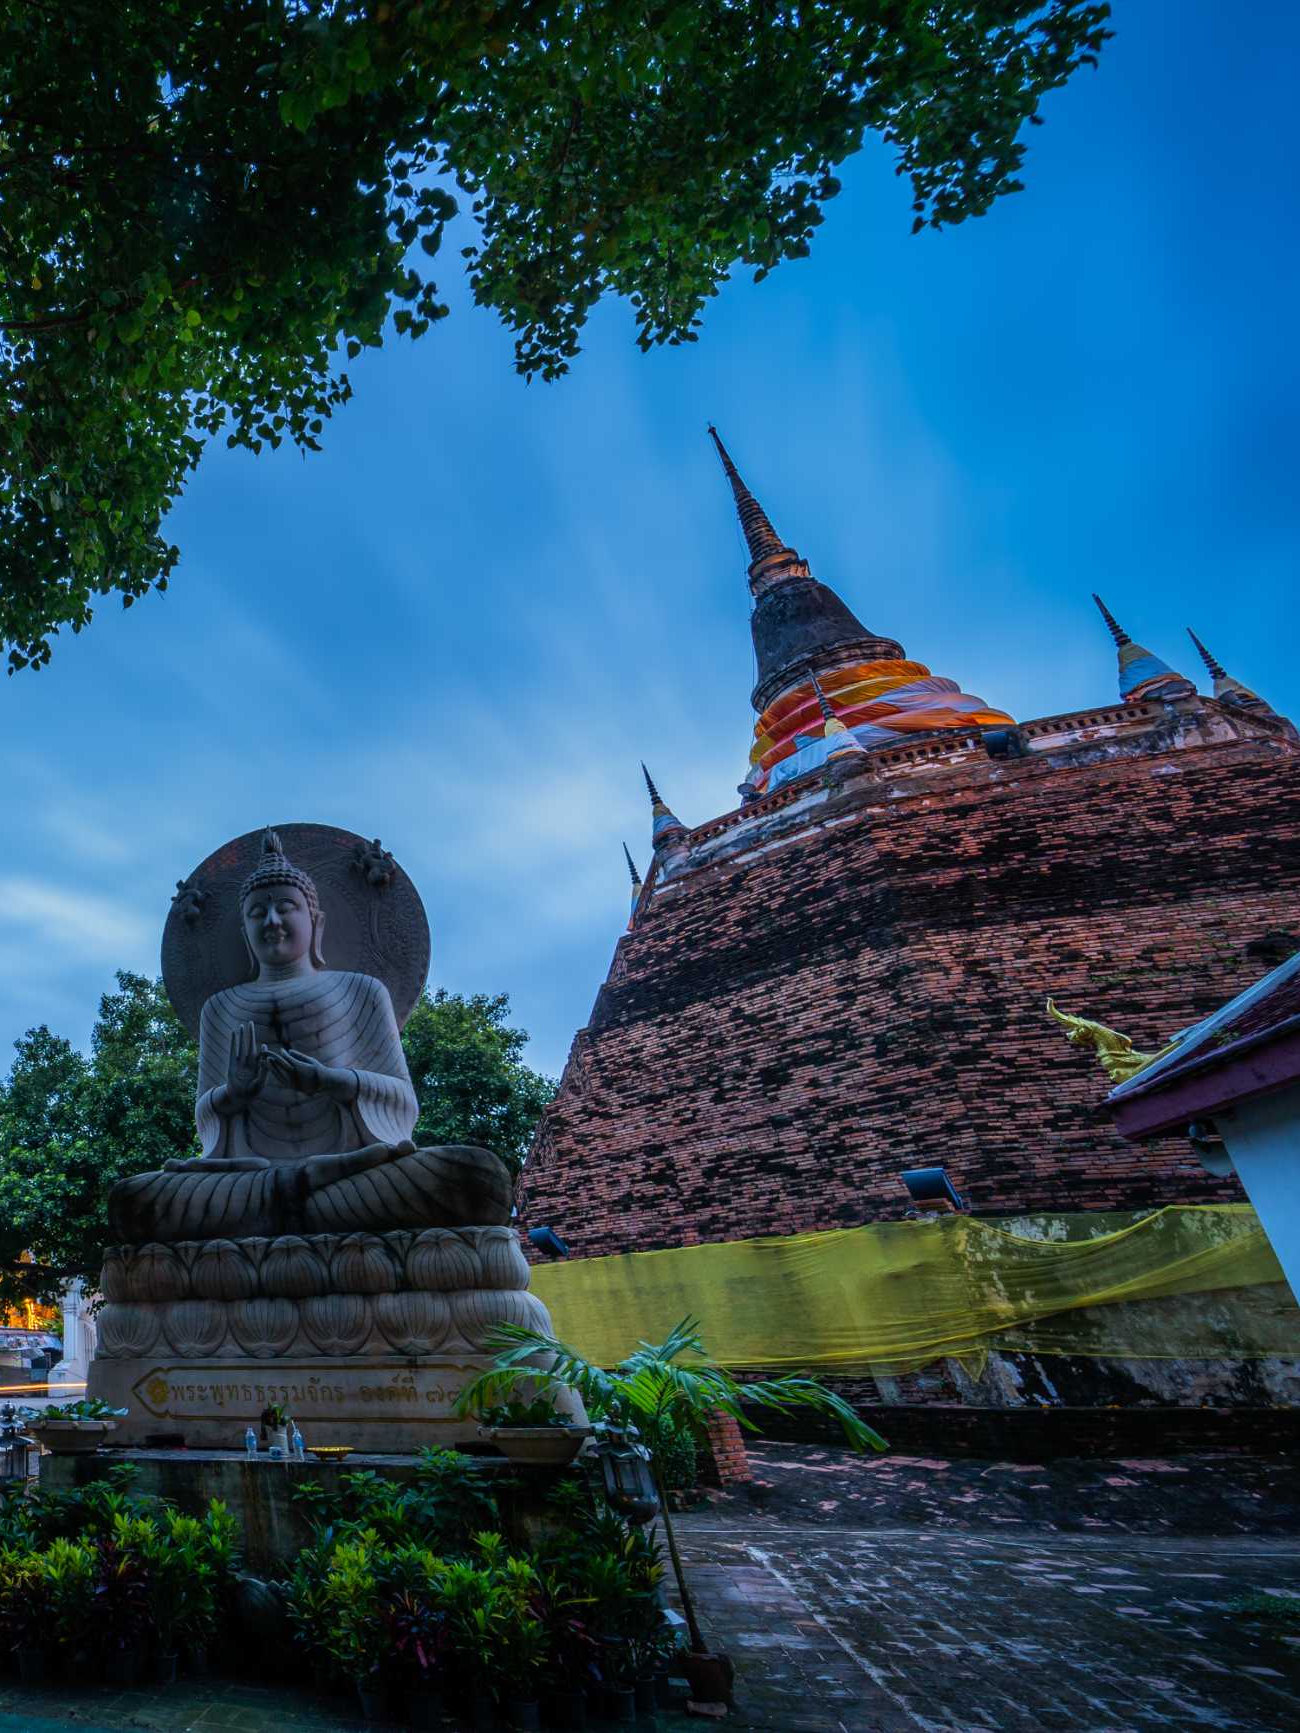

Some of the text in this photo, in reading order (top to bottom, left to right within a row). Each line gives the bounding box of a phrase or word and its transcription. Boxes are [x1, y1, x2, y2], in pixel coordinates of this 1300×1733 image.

[171, 1376, 345, 1408] พระพุทธธรรมจักร
